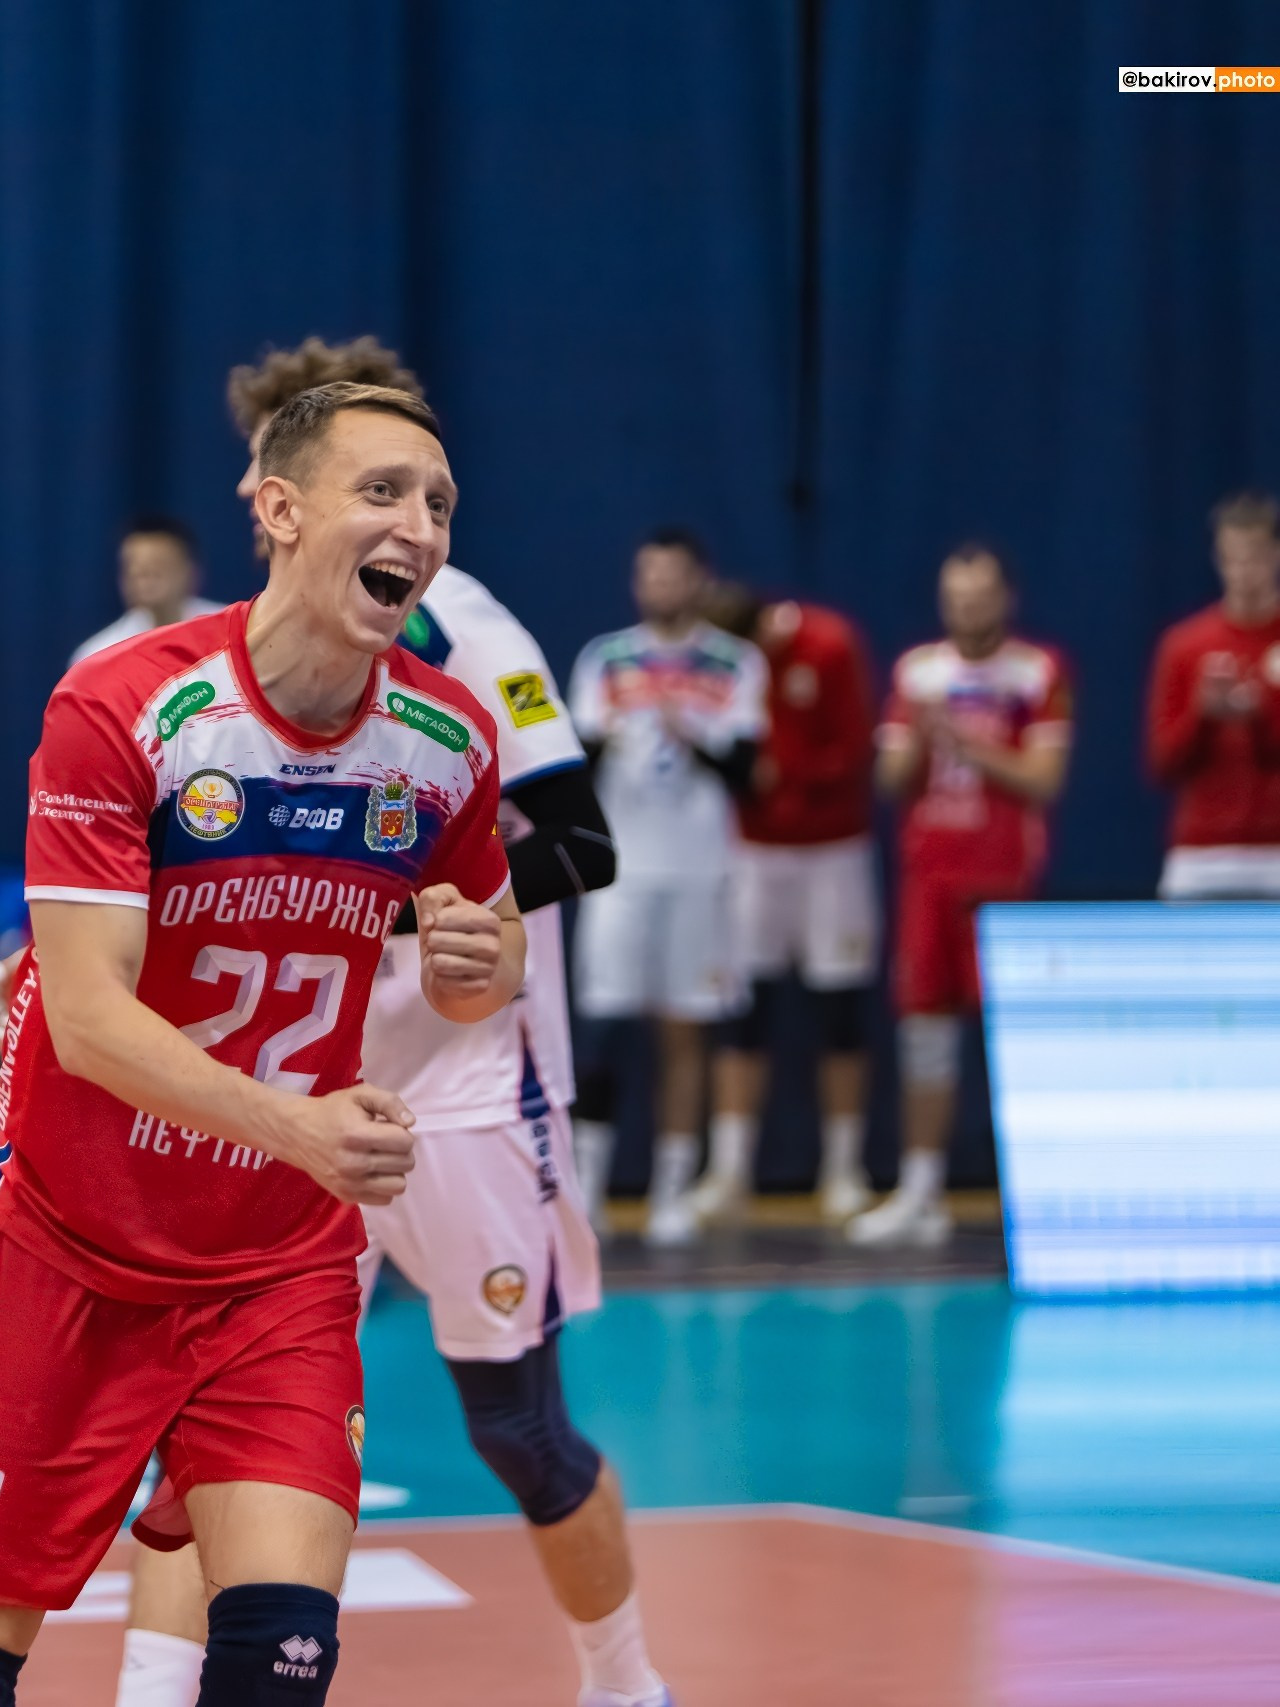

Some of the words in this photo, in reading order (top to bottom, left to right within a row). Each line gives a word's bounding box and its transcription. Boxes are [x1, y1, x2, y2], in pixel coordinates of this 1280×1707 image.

[405, 706, 464, 747] МЕГАФОН
[278, 763, 337, 777] ENSEN
[288, 807, 345, 830] ВФВ
[159, 874, 400, 946] ОРЕНБУРЖЬЕ
[177, 944, 349, 1096] 22
